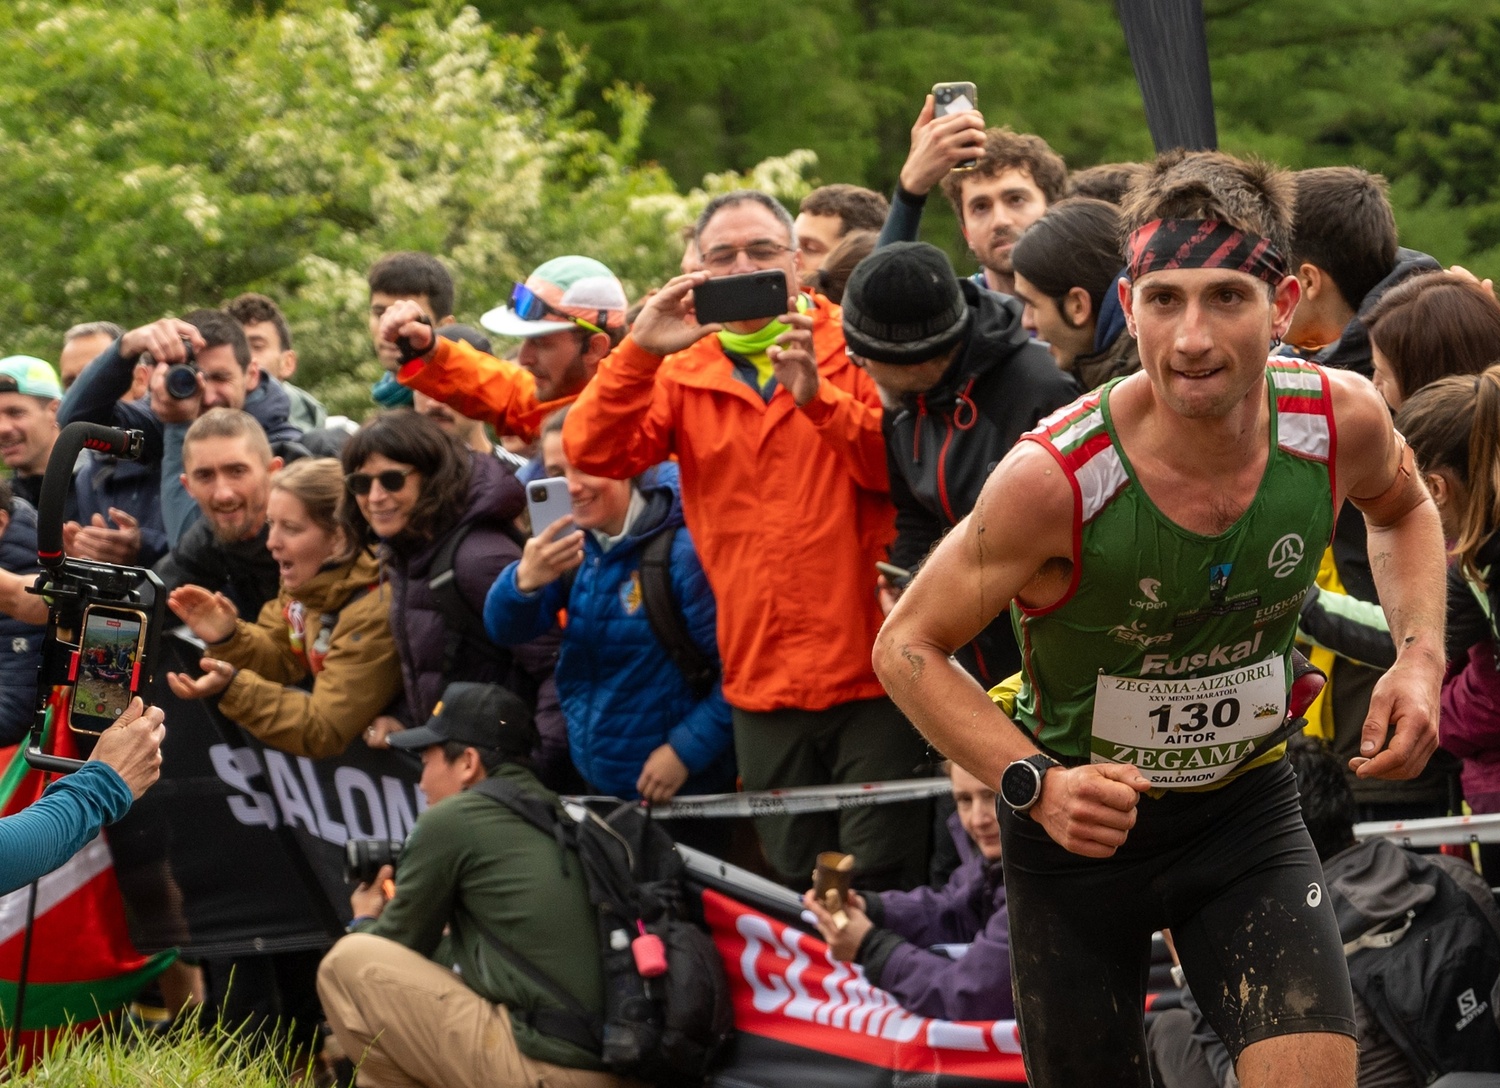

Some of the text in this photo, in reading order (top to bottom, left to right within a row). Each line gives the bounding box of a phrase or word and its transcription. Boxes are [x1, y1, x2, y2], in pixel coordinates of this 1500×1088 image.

[1138, 630, 1263, 677] Euskal
[1115, 663, 1273, 694] ZEGAMA-AIZKORRI
[1148, 694, 1166, 702] XXV
[1168, 694, 1195, 702] MENDI
[1148, 697, 1240, 733] 130
[1164, 731, 1216, 744] AITOR
[1111, 740, 1257, 770] ZEGAMA
[1150, 772, 1216, 783] SALOMON
